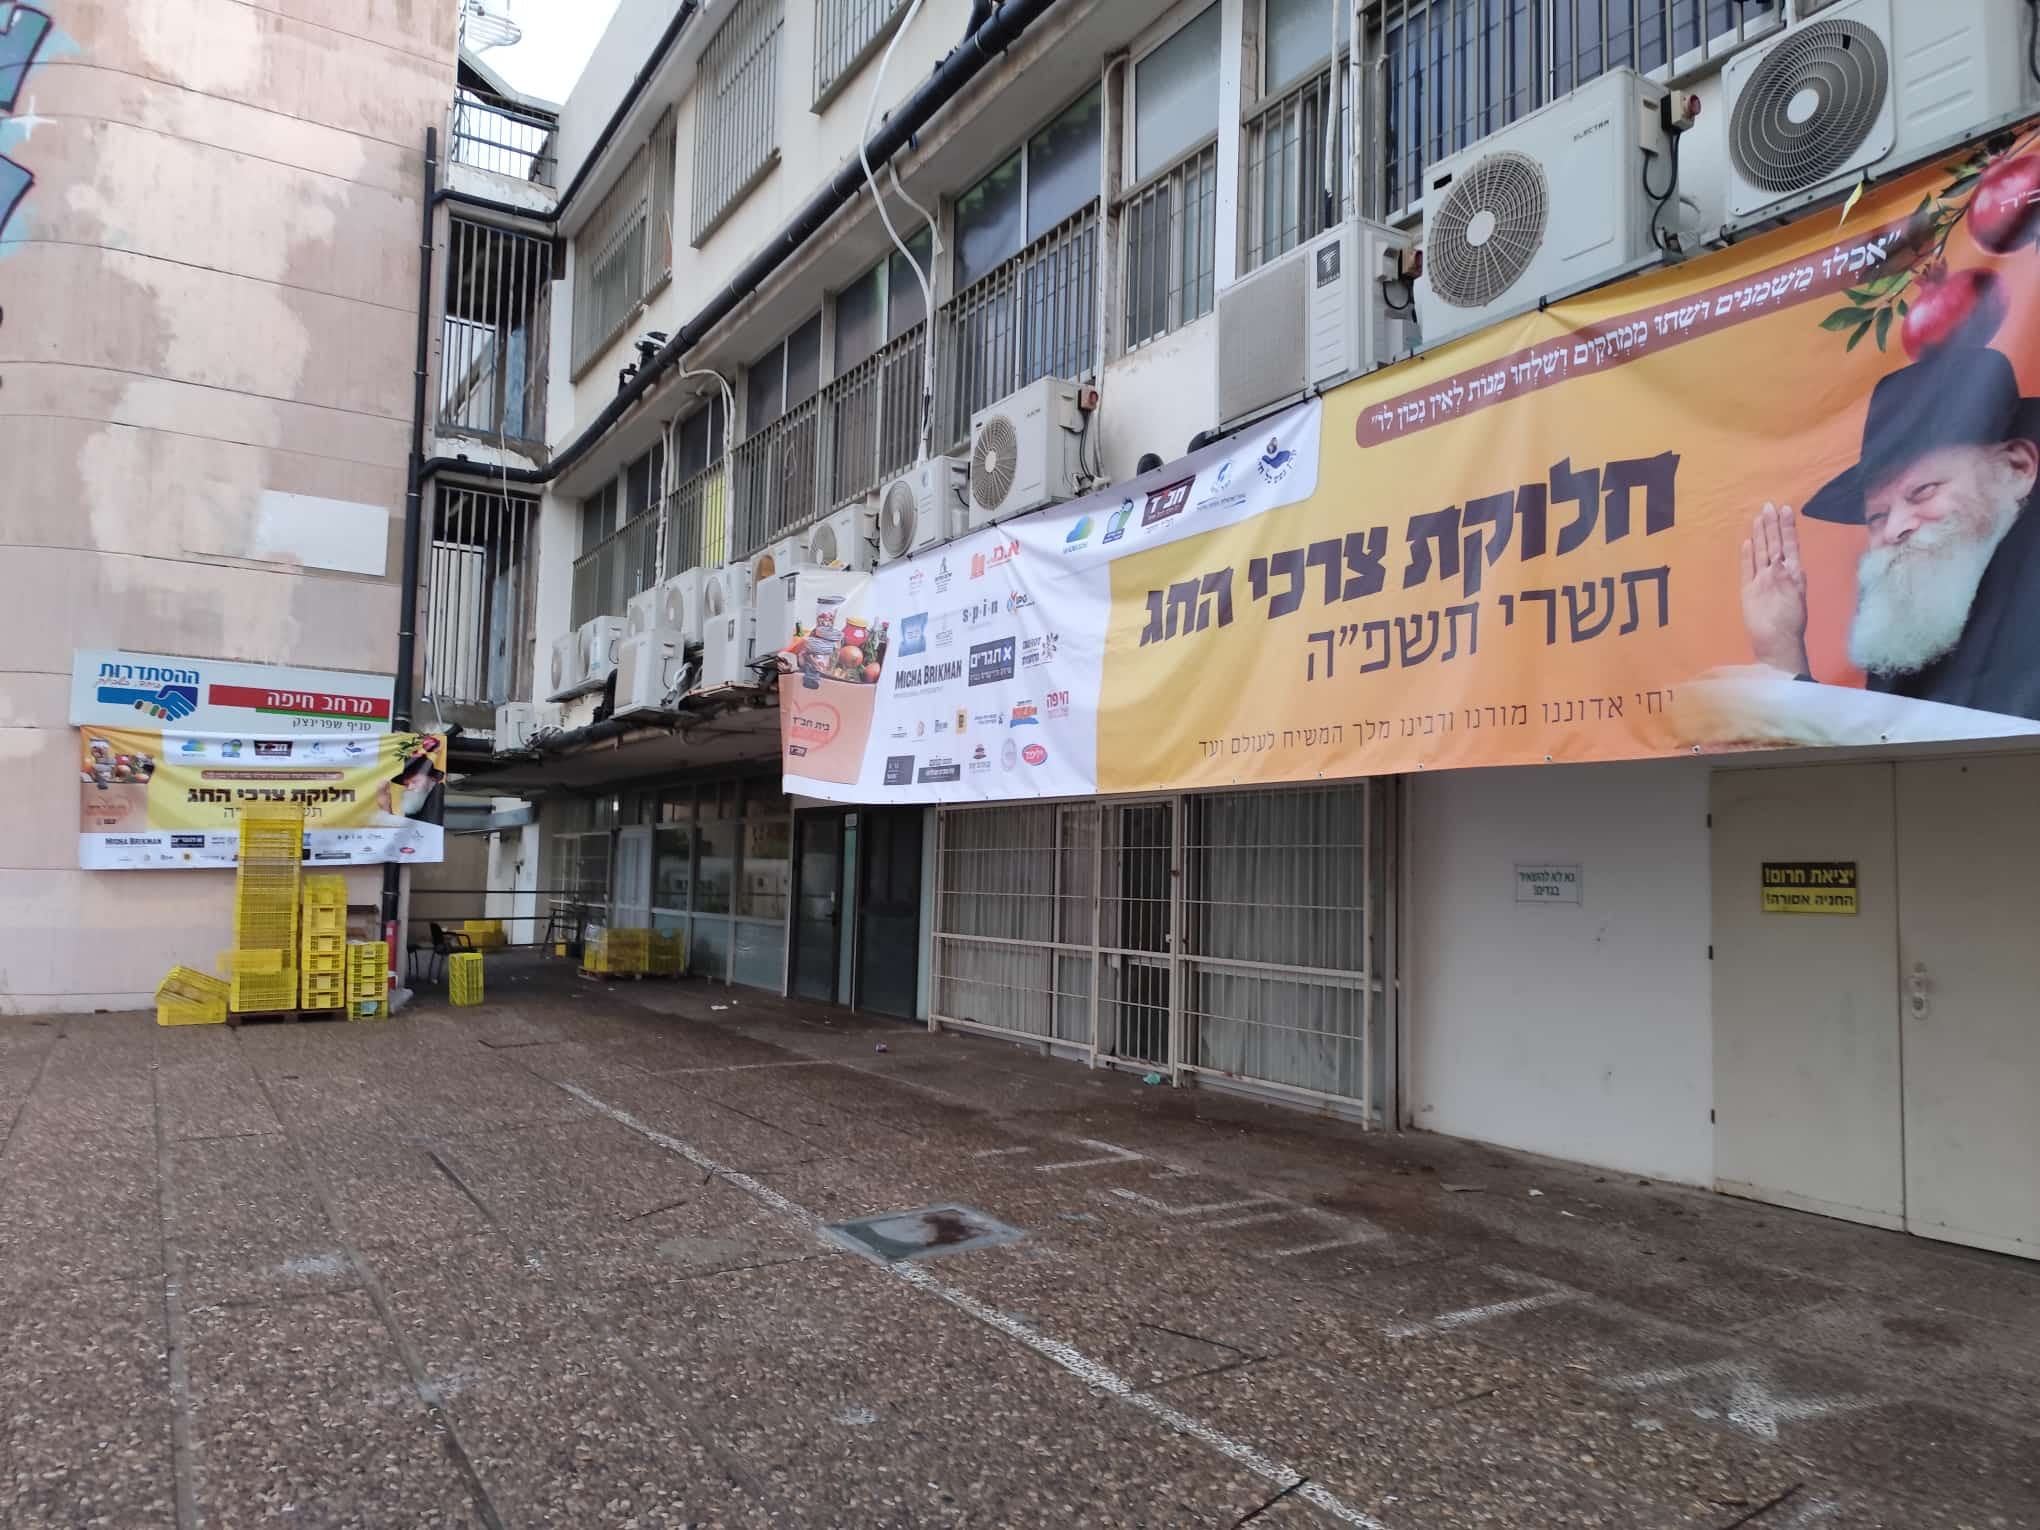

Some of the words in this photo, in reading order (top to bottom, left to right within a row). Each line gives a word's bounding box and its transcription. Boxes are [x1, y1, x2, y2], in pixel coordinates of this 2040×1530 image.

[1402, 450, 1682, 599] חלוקת
[1249, 526, 1389, 620] צרכי
[1139, 566, 1234, 647] החג
[1499, 565, 1671, 646] תשרי
[99, 663, 200, 684] ההסתדרות
[924, 661, 962, 686] BRIKMAN
[267, 692, 314, 708] חיפה
[322, 697, 373, 713] מרחב
[1543, 695, 1624, 724] אדוננו
[1635, 689, 1674, 715] יחי
[292, 718, 342, 729] שפרינצק
[347, 720, 371, 732] סניף
[1400, 711, 1454, 737] ורבינו
[1465, 702, 1527, 729] מורנו
[1231, 730, 1275, 754] לעולם
[1282, 724, 1343, 749] המשיח
[1352, 718, 1391, 746] מלך
[1199, 737, 1225, 760] ועד
[188, 787, 231, 802] החג
[238, 788, 286, 802] צרכי
[290, 786, 356, 805] חלוקת
[1765, 867, 1806, 883] חרום!
[1810, 868, 1854, 883] יציאת
[1766, 893, 1809, 905] אסורה!
[1815, 895, 1853, 906] החניה
